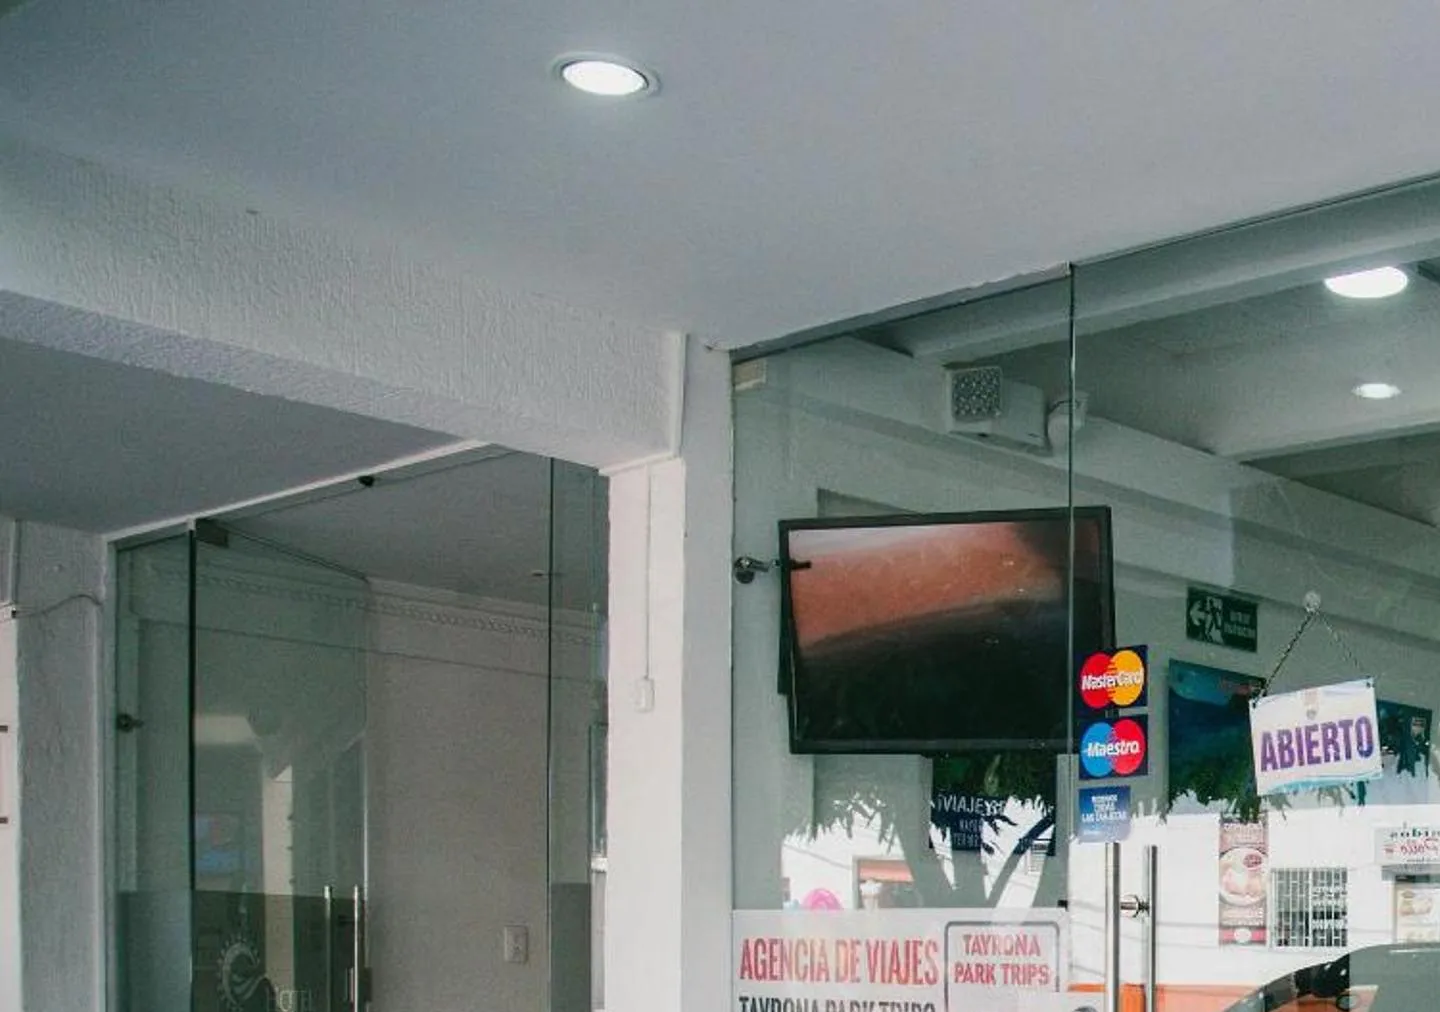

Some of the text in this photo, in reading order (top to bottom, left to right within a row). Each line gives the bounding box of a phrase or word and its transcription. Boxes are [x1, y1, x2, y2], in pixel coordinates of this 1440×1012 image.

[1087, 739, 1141, 758] Maestro
[1260, 716, 1374, 772] ABIERTO
[962, 934, 1041, 956] TAYRONA
[739, 937, 939, 986] AGENCIA DE VIAJES
[955, 962, 1050, 986] PARK TRIPS
